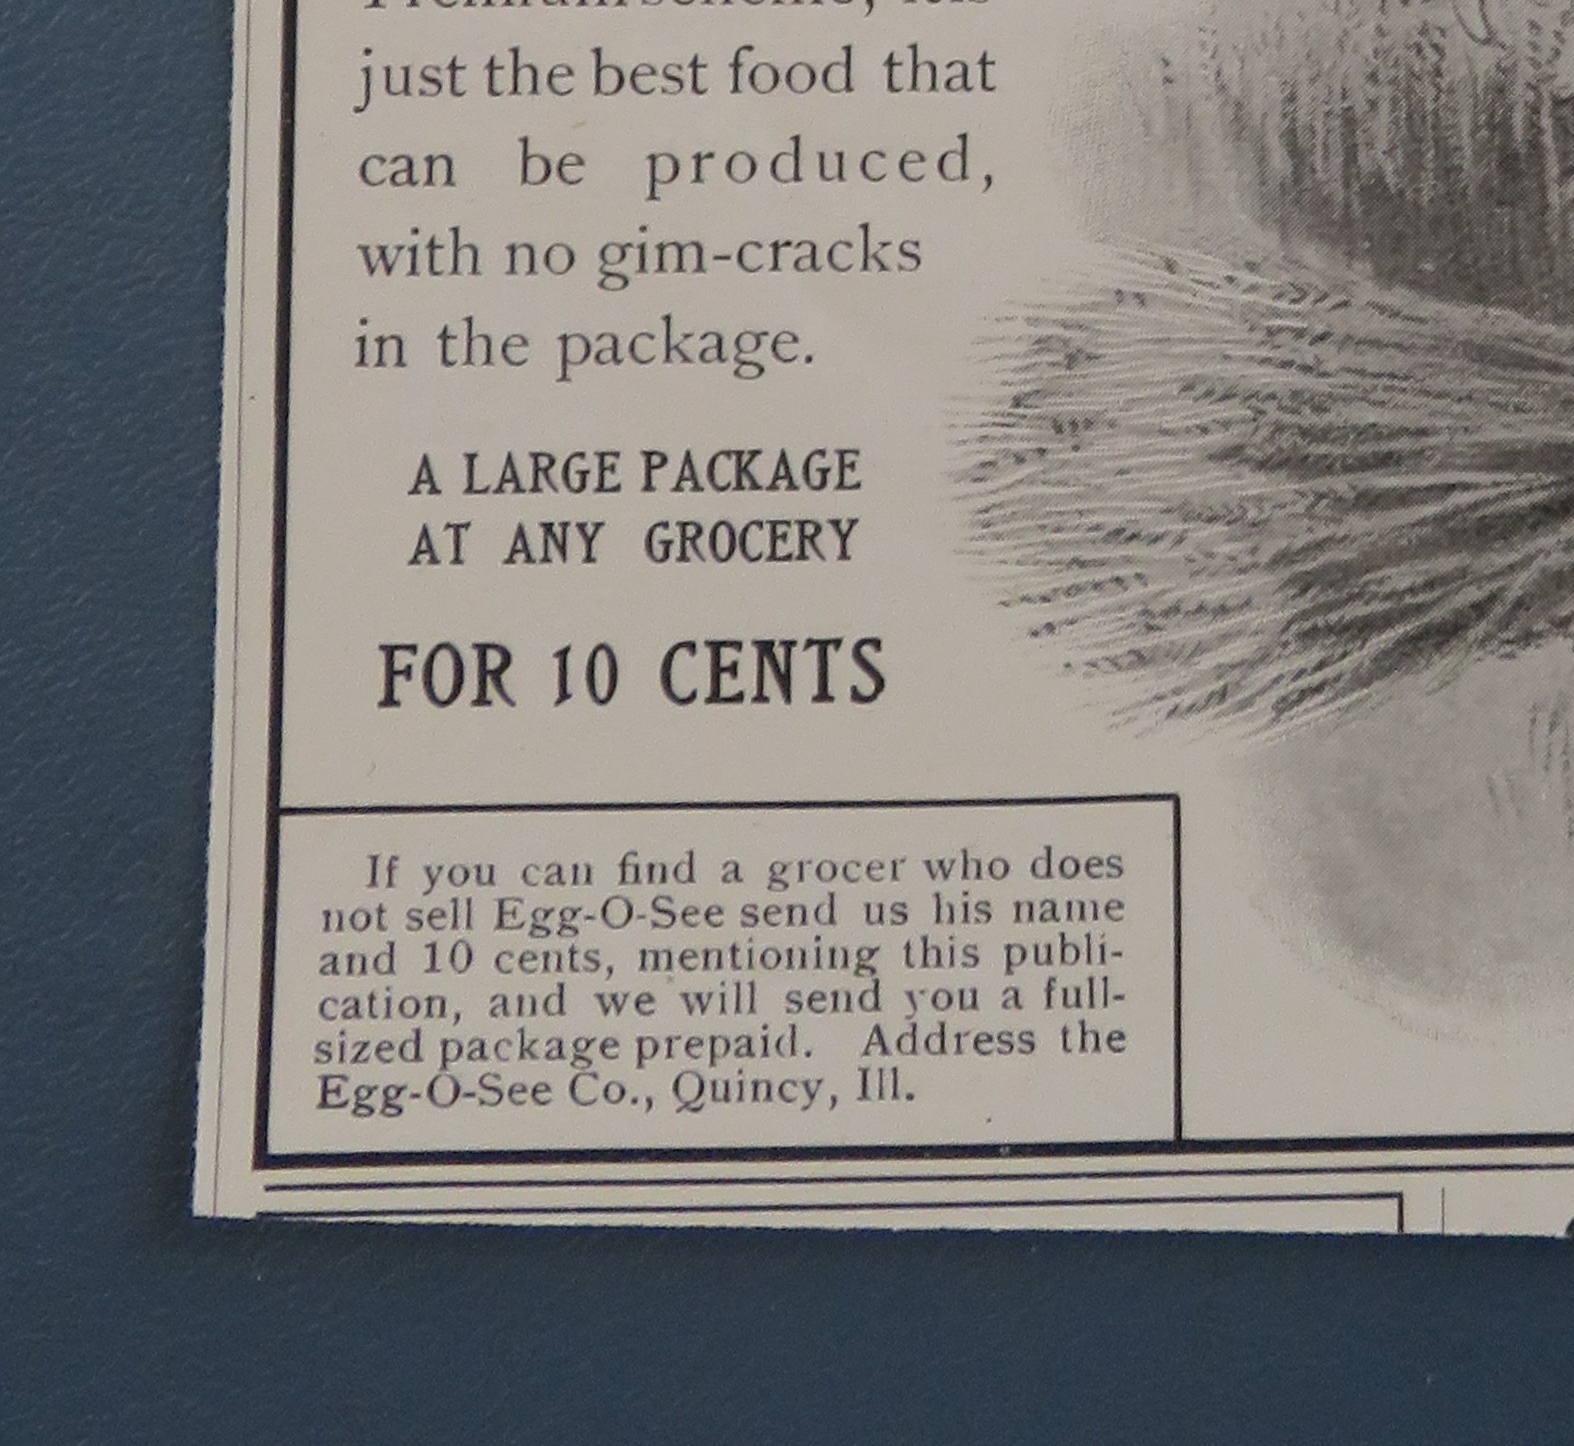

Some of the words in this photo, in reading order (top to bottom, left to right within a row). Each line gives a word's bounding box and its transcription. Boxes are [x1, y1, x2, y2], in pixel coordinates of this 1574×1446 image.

[359, 154, 456, 187] can
[518, 135, 585, 185] be
[645, 132, 993, 201] produced,
[357, 226, 481, 277] with
[505, 242, 576, 275] no
[597, 222, 921, 291] gim-cracks
[407, 453, 442, 495] A
[463, 450, 622, 495] LARGE
[640, 448, 862, 493] PACKAGE
[408, 521, 472, 566] AT
[502, 521, 606, 565] ANY
[644, 517, 859, 564] GROCERY
[377, 641, 516, 709] FOR
[553, 642, 619, 707] 10
[660, 637, 886, 706] CENTS
[366, 854, 399, 888] If
[423, 864, 495, 896] you
[521, 862, 592, 887] can
[618, 849, 696, 885] find
[721, 860, 743, 884] a
[767, 858, 906, 892] grocer
[923, 848, 1010, 881] who
[1030, 845, 1124, 880] does
[322, 903, 387, 933] not
[406, 897, 473, 931] sell
[494, 895, 724, 939] Egg-O-See
[740, 892, 837, 928] send
[864, 902, 908, 925] us
[933, 891, 992, 925] his
[1013, 899, 1124, 923] name
[319, 941, 396, 976] and
[424, 939, 473, 974] 10
[495, 944, 613, 980] cents,
[639, 935, 880, 977] mentioning
[904, 934, 980, 968] this
[1004, 932, 1123, 975] publi-
[319, 986, 461, 1026] cation,
[489, 982, 566, 1018] and
[594, 992, 655, 1017] we
[679, 980, 756, 1016] will
[786, 977, 881, 1014] send
[905, 987, 979, 1020] you
[1001, 987, 1023, 1010] a
[1044, 975, 1125, 1010] full-
[314, 1027, 425, 1066] sized
[439, 1026, 622, 1072] package
[636, 1023, 812, 1069] prepaid.
[861, 1021, 1036, 1056] Address
[1061, 1019, 1126, 1053] the
[316, 1072, 552, 1118] Egg-O-See
[569, 1072, 654, 1114] Co.,
[672, 1068, 838, 1113] Quincy,
[857, 1066, 915, 1101] Ill.
